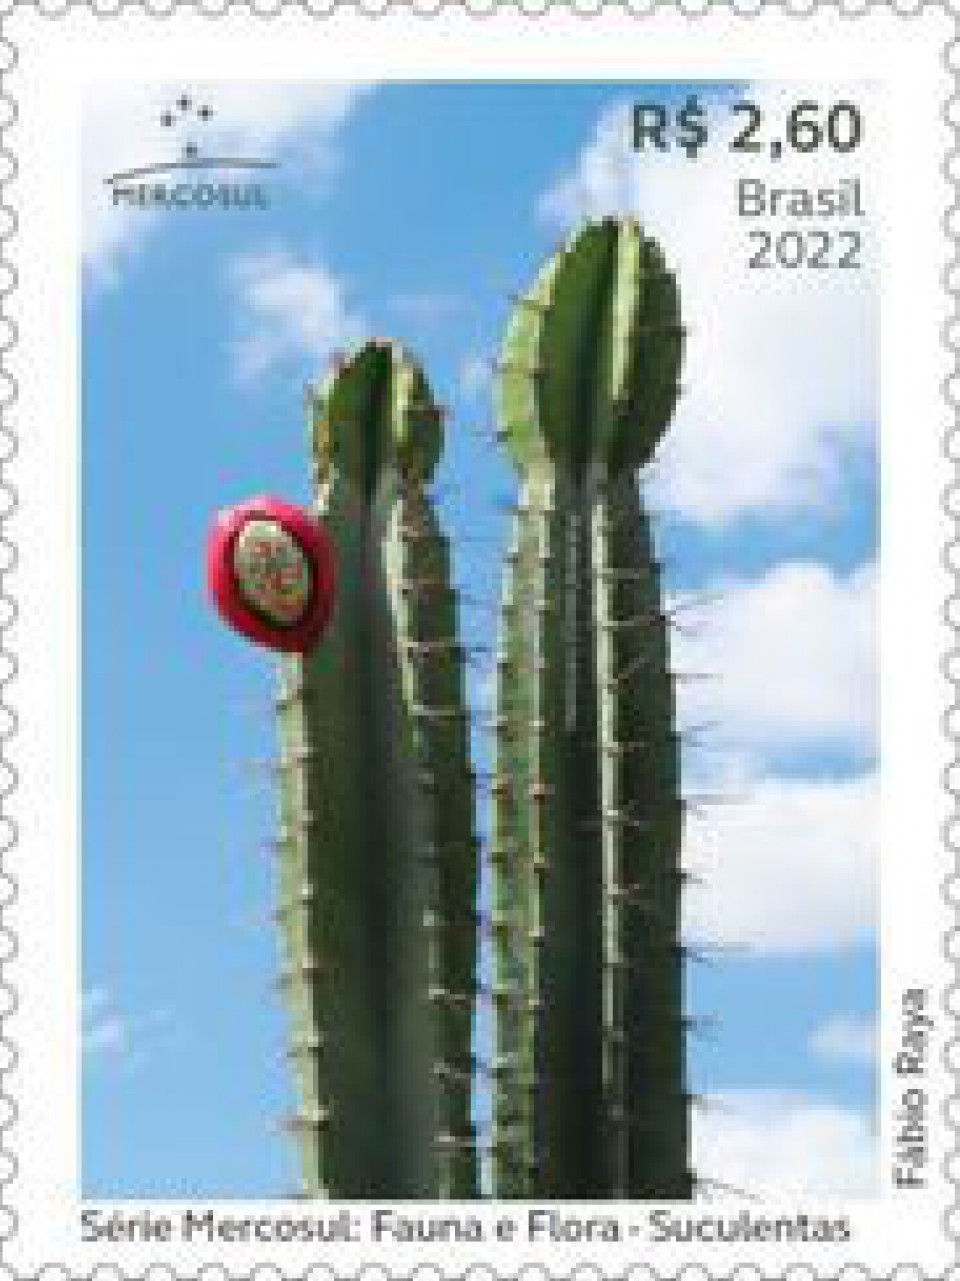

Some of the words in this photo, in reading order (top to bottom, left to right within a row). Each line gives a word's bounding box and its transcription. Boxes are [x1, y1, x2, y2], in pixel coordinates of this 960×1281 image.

[630, 96, 708, 158] R$
[729, 101, 863, 160] 2,60
[108, 183, 270, 208] MERCOSUL
[735, 177, 864, 218] Brasil
[746, 230, 863, 270] 2022
[893, 987, 934, 1076] Raya
[893, 1088, 926, 1186] Fábio
[79, 1210, 172, 1242] Série
[183, 1210, 358, 1242] Mercosul:
[372, 1210, 484, 1242] Fauna
[494, 1218, 516, 1242] e
[526, 1210, 620, 1242] Flora
[648, 1210, 852, 1242] Suculentas
